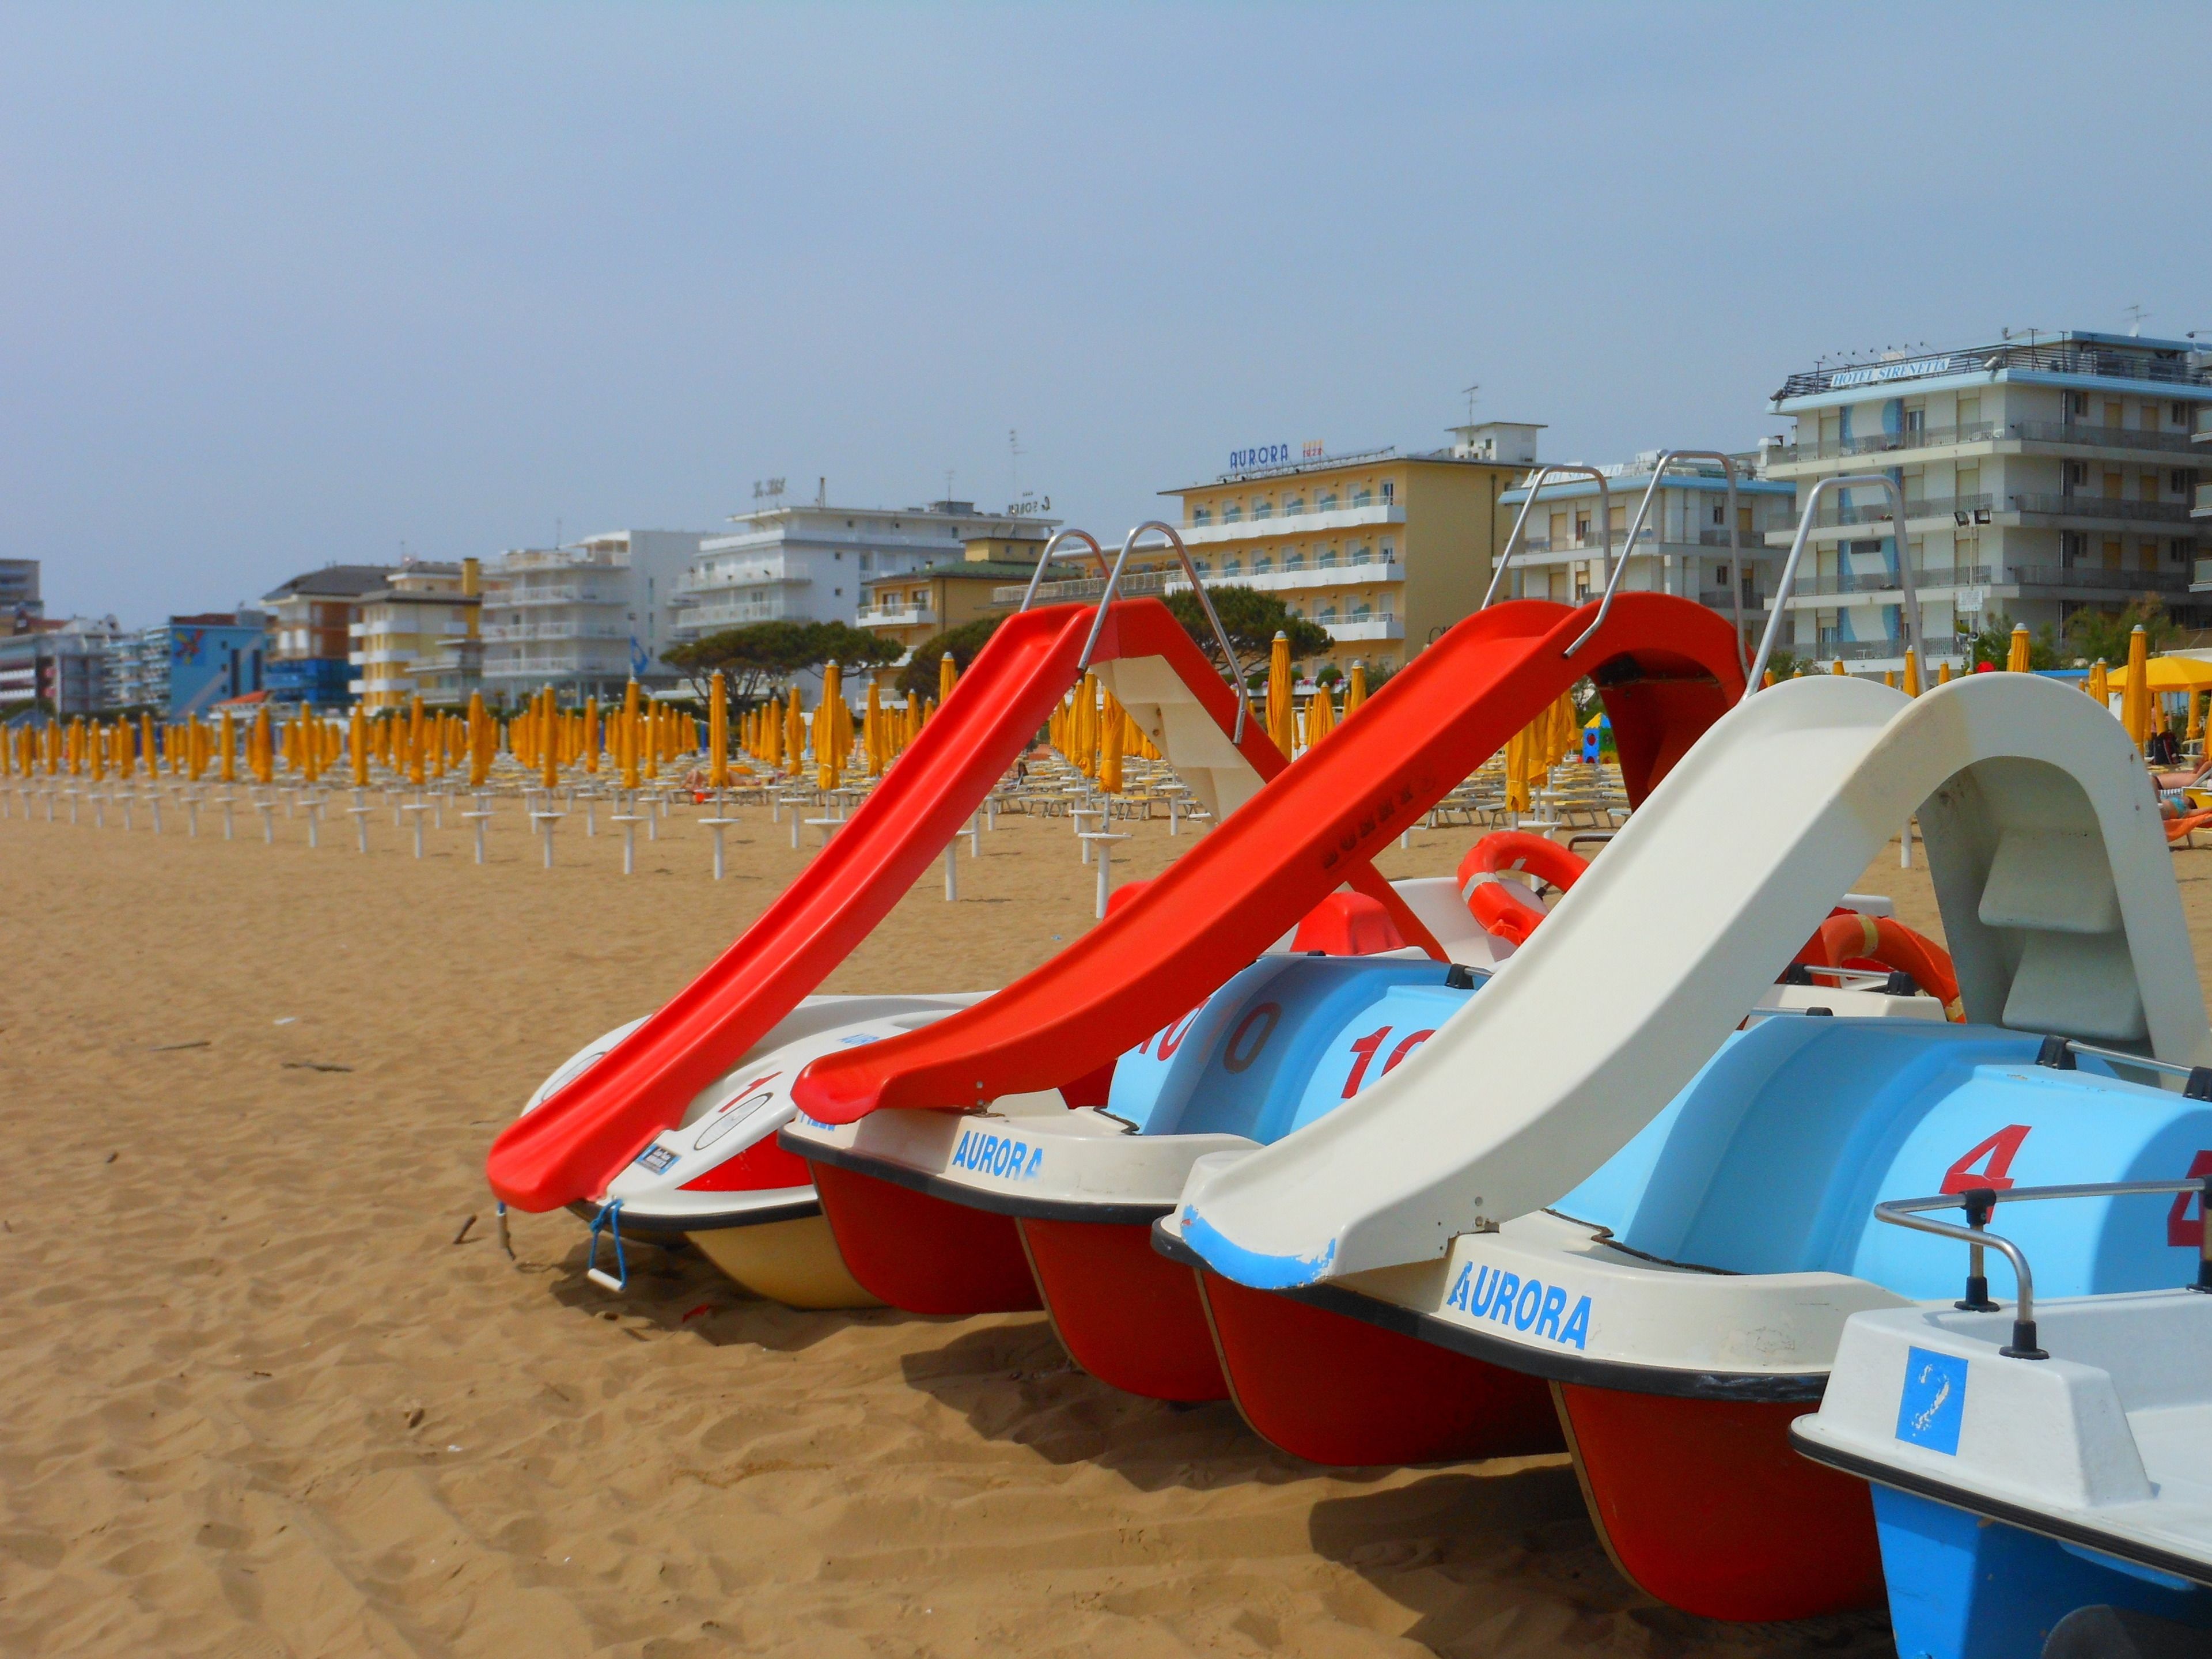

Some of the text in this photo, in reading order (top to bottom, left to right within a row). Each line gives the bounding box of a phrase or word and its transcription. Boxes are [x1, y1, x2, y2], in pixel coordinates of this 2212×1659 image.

[1834, 372, 1874, 385] HOTEL
[1230, 444, 1288, 468] AURORA
[718, 1071, 783, 1113] 1
[952, 1131, 1043, 1180] AURORA
[1939, 1124, 2032, 1224] 4
[1446, 1261, 1592, 1350] AURORA
